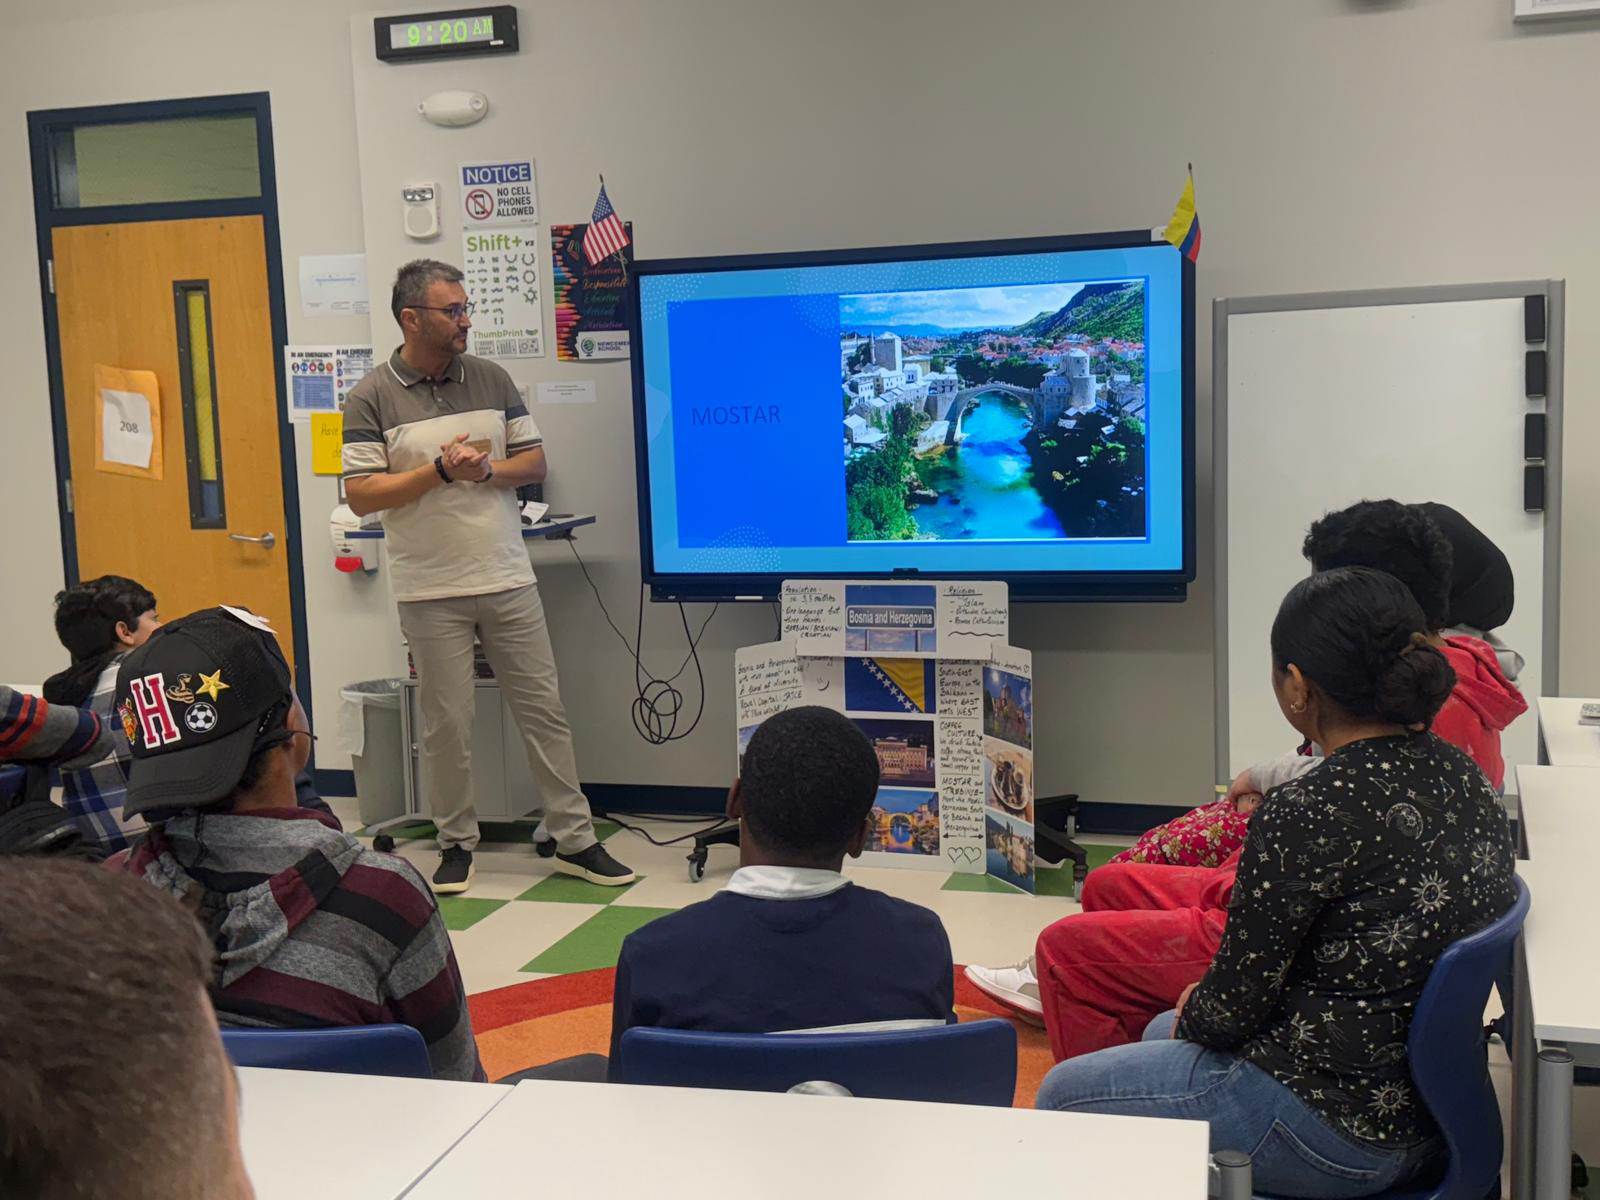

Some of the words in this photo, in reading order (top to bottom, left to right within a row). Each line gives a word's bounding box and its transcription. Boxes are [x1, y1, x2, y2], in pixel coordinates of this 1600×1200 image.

[407, 20, 468, 46] 9:20
[472, 18, 494, 35] AM
[466, 165, 529, 184] NOTICE
[497, 187, 509, 196] NO
[511, 186, 531, 195] CELL
[498, 196, 531, 206] PHONES
[496, 206, 534, 217] ALLOWED
[467, 235, 522, 252] Shift+
[474, 328, 523, 339] ThumbPrint
[691, 404, 781, 426] MOSTAR
[120, 421, 139, 434] 208
[849, 610, 873, 625] Bosnia
[875, 611, 888, 624] and
[889, 610, 933, 627] Herzegovina
[130, 672, 181, 749] H
[957, 707, 978, 716] WEST
[942, 777, 972, 786] MOSTAR
